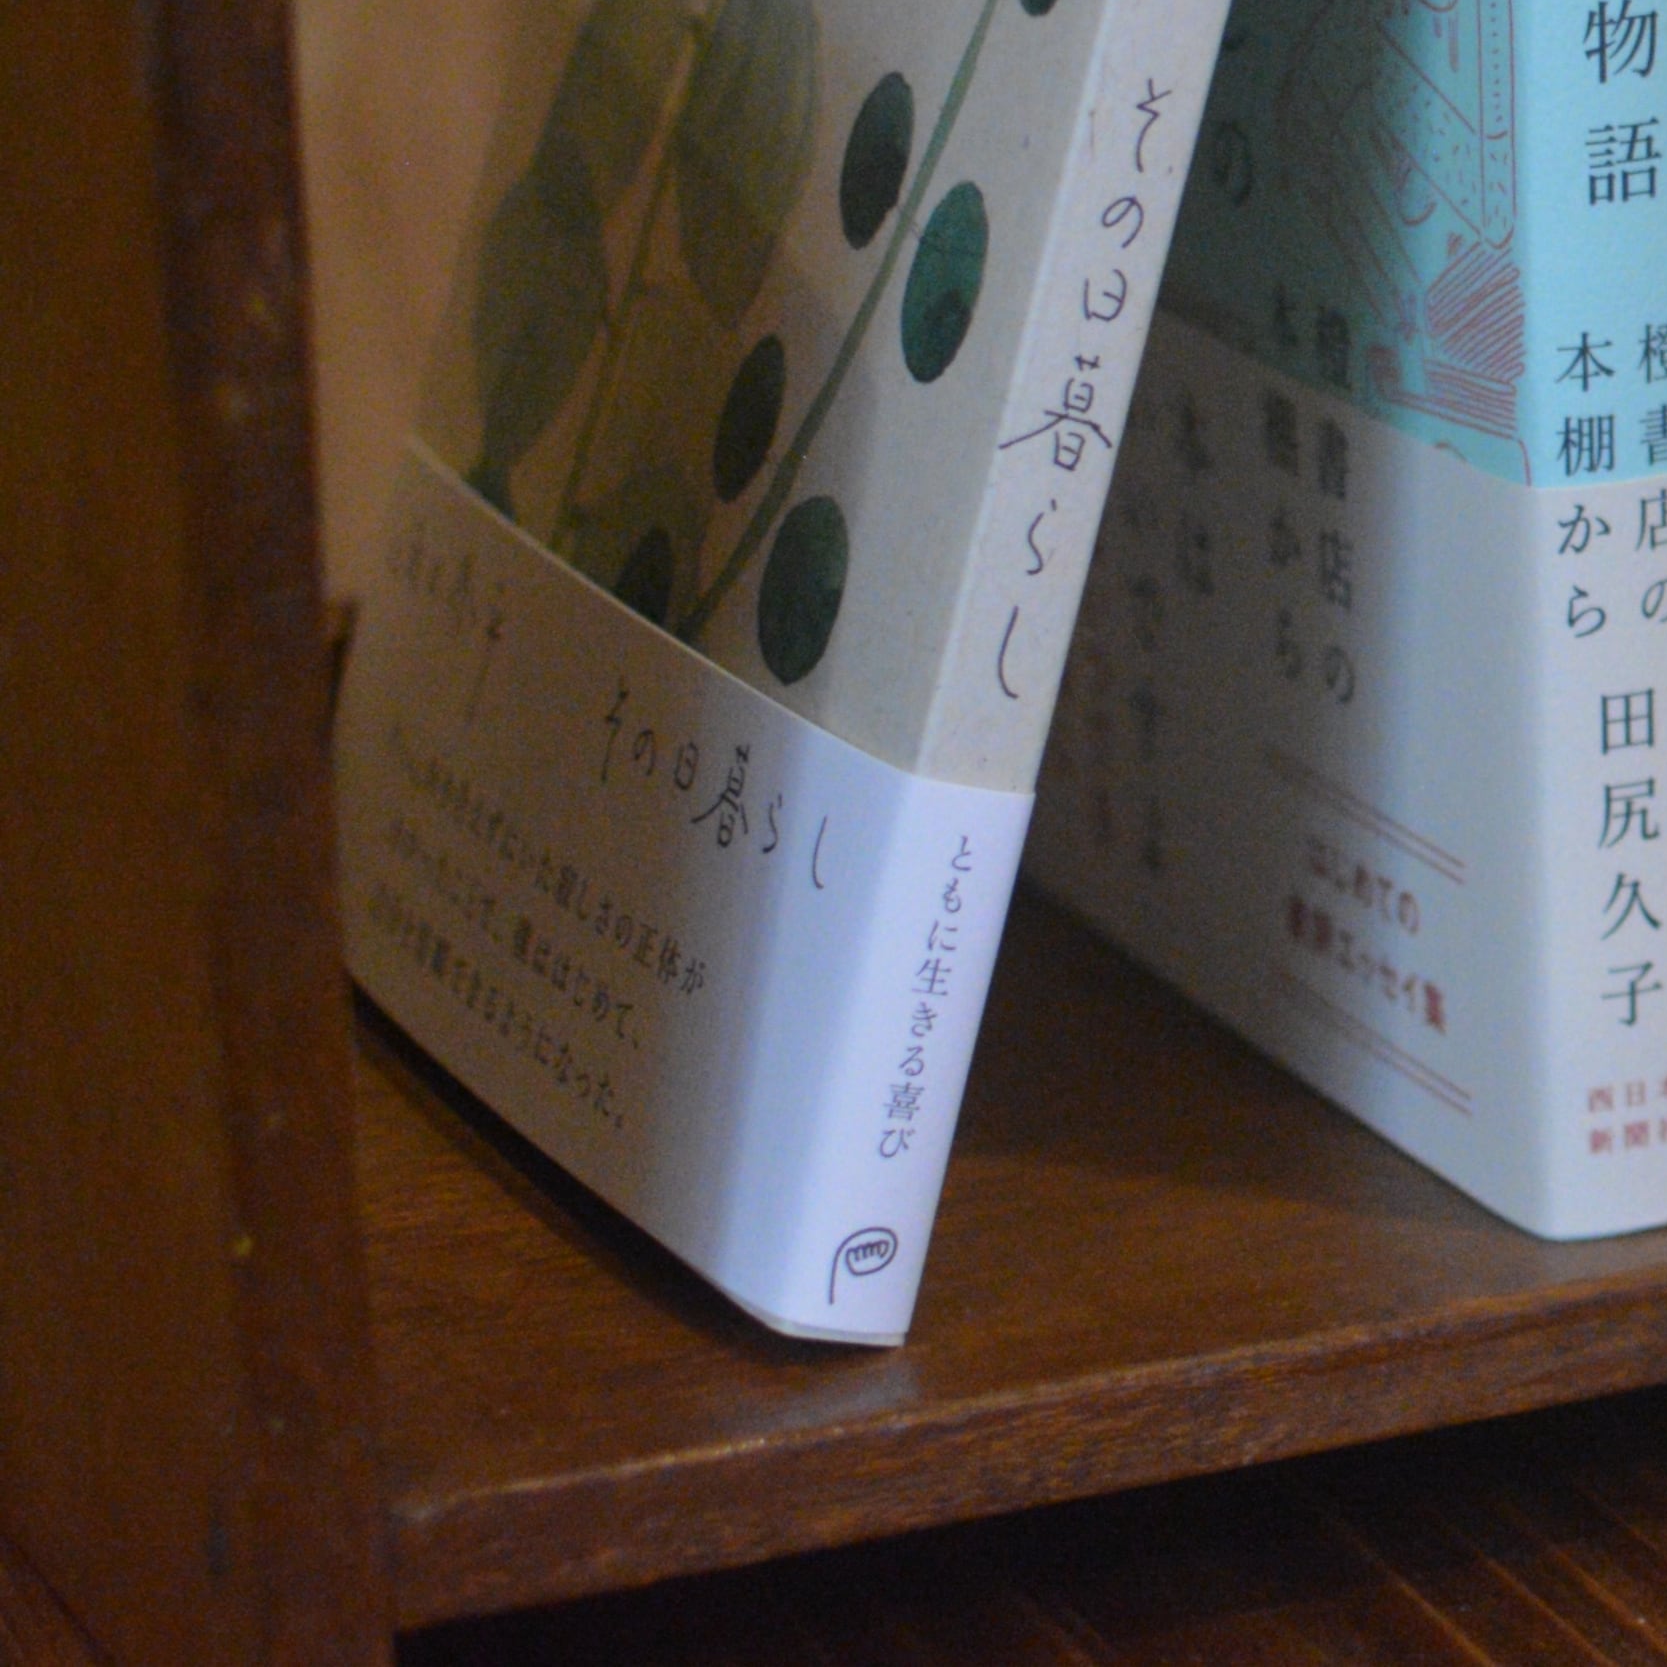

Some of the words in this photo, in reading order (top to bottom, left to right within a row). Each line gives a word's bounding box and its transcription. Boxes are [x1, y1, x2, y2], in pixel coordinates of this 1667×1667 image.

[998, 77, 1173, 700] その日暮らし
[1555, 331, 1616, 638] 本棚から
[601, 674, 828, 890] その日暮らし
[1598, 687, 1663, 1027] 田尻久子
[879, 835, 973, 1159] ともに生きる喜び
